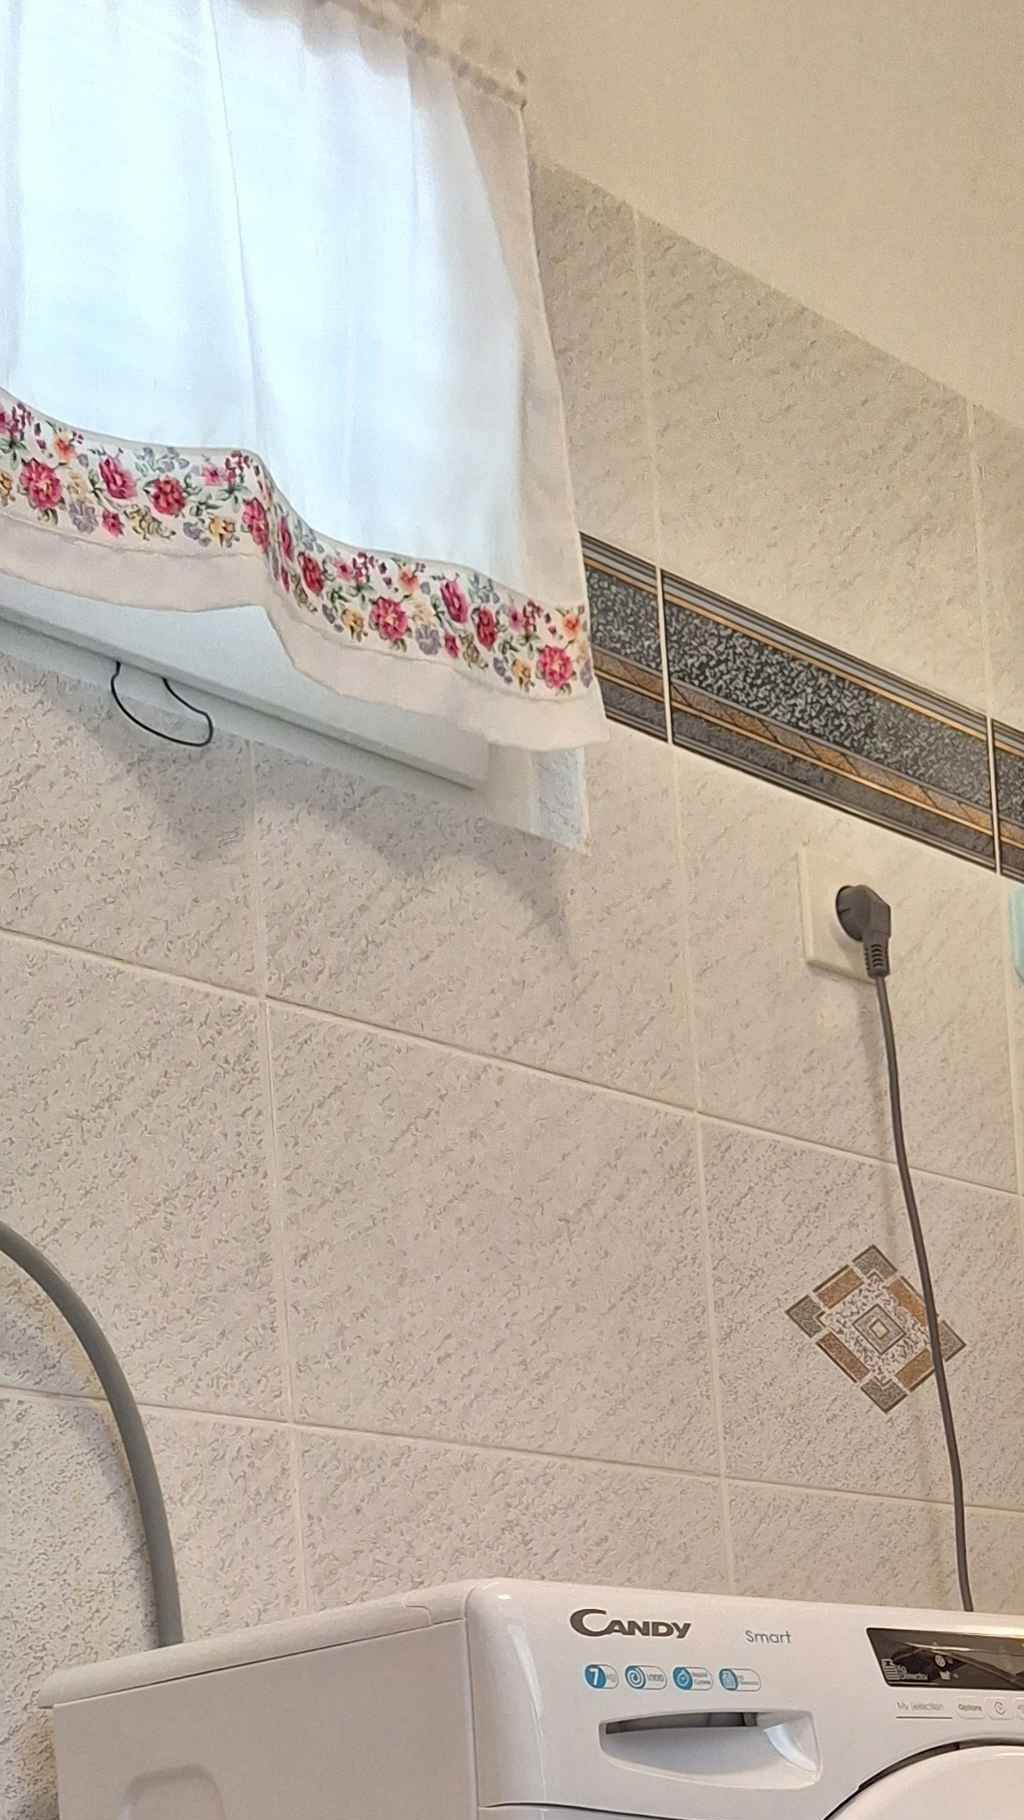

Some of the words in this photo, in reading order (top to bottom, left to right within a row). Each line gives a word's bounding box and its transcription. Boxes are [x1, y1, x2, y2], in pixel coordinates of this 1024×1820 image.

[569, 1608, 691, 1639] CANDY
[744, 1630, 791, 1644] Smart
[588, 1668, 599, 1686] 7
